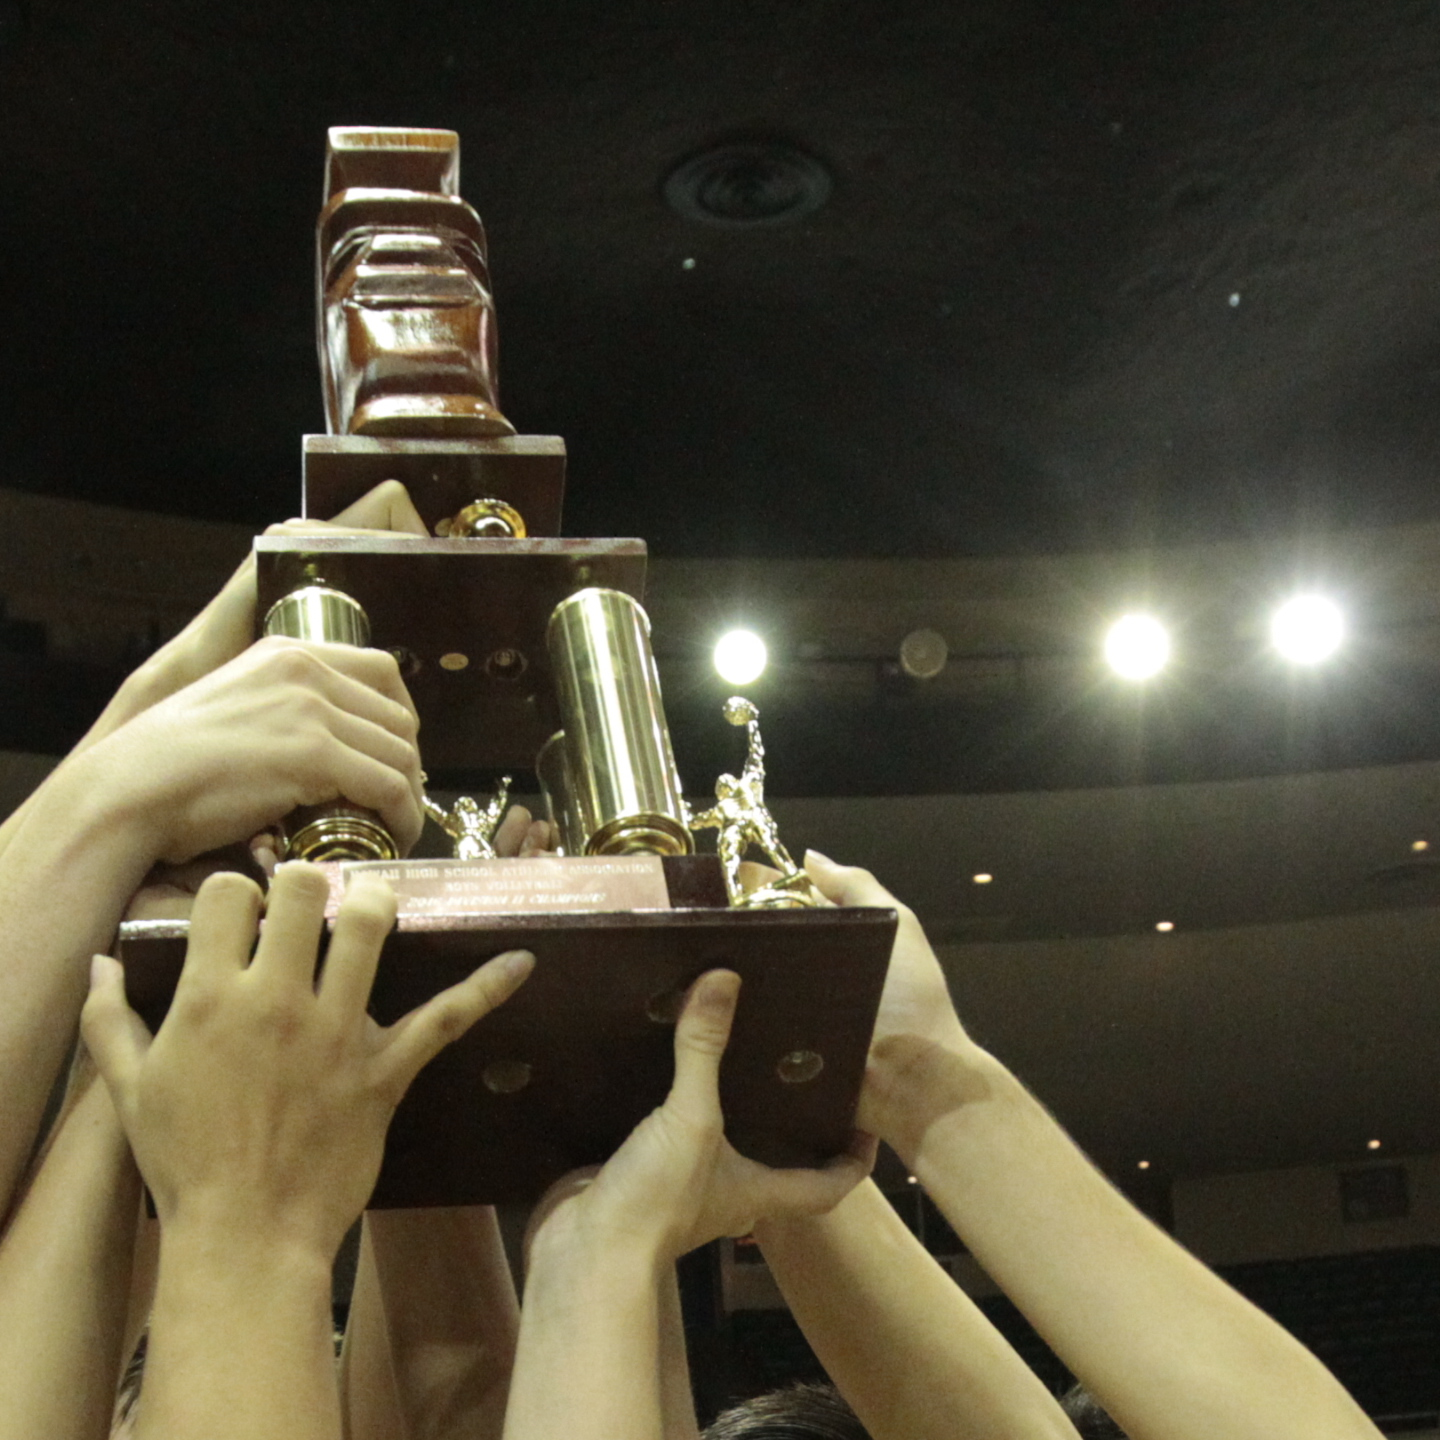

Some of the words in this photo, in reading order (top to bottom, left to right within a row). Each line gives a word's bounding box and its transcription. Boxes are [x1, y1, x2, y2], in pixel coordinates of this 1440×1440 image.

[406, 867, 438, 878] HIGH
[444, 867, 496, 877] SCHOOL
[569, 863, 654, 875] ASSOCIATION
